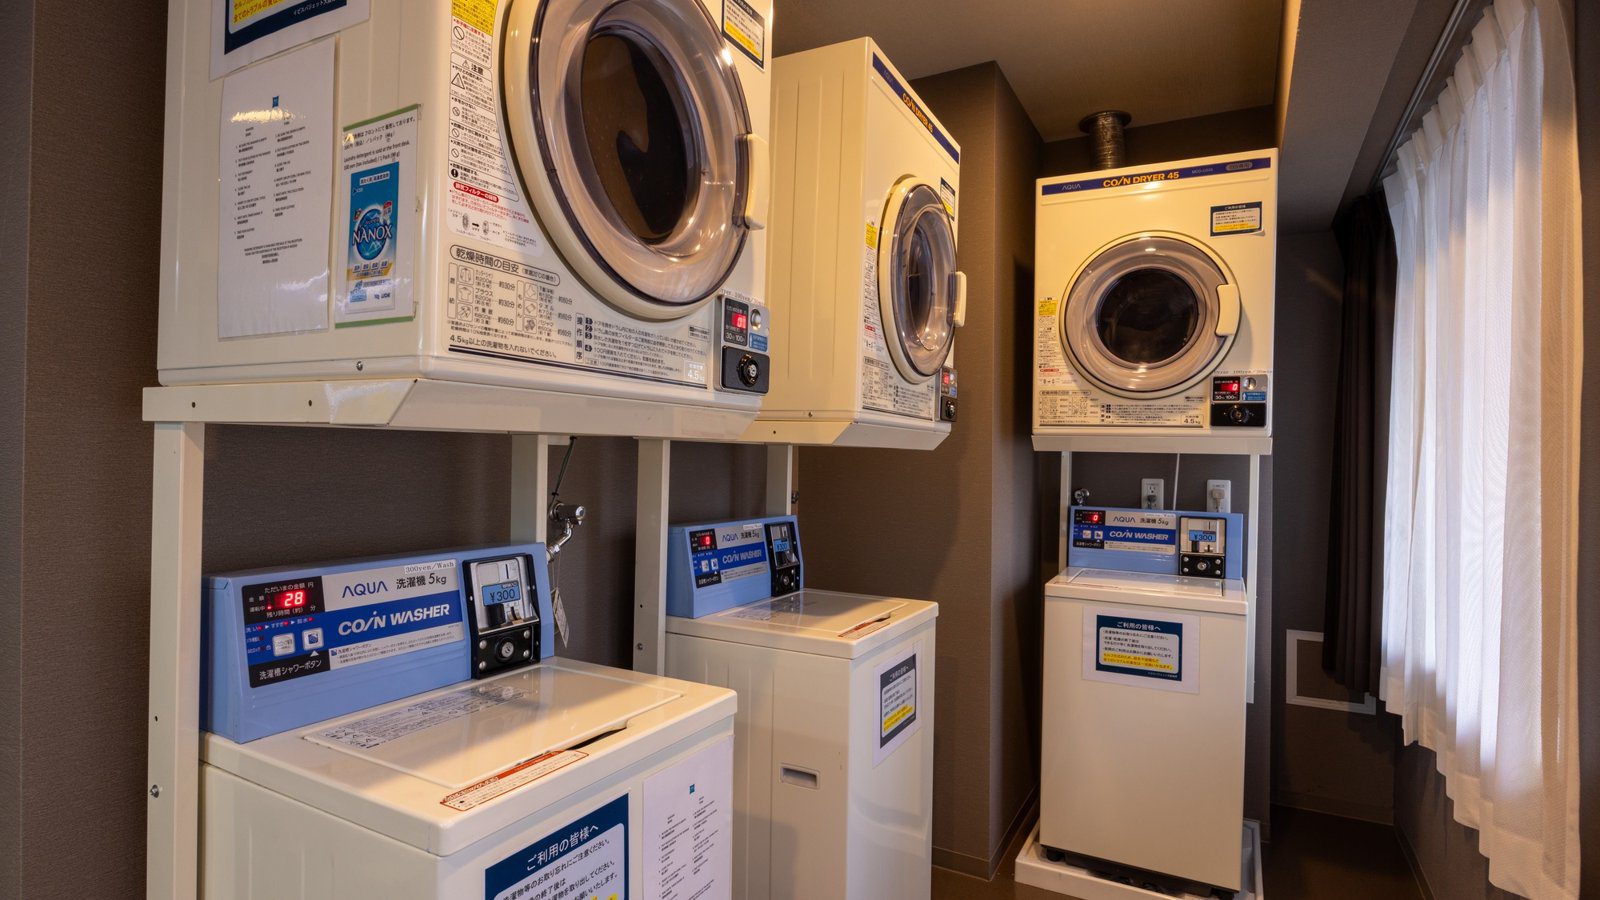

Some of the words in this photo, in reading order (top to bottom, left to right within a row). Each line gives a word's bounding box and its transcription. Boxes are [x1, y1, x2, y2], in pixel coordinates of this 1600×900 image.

[471, 64, 484, 75] 注意
[1133, 173, 1165, 184] DRYER
[1167, 171, 1180, 179] 45
[353, 224, 392, 245] NANOX
[456, 248, 519, 274] 乾燥時間の目安
[722, 533, 738, 543] AQUA
[1134, 532, 1168, 541] WASHER
[740, 549, 762, 560] WASHER
[405, 562, 454, 573] 300yen/Wash
[265, 582, 305, 593] ただいまの金額
[342, 580, 388, 598] AQUA
[396, 575, 426, 589] 洗濯機
[428, 573, 447, 585] 5kg
[284, 592, 304, 606] 28
[490, 589, 516, 602] ¥300
[390, 604, 450, 625] WASHER
[1117, 622, 1161, 631] ご利用の皆様へ
[259, 659, 322, 680] 洗濯槽シャワーボタン
[527, 825, 598, 871] ご利用の皆様へ
